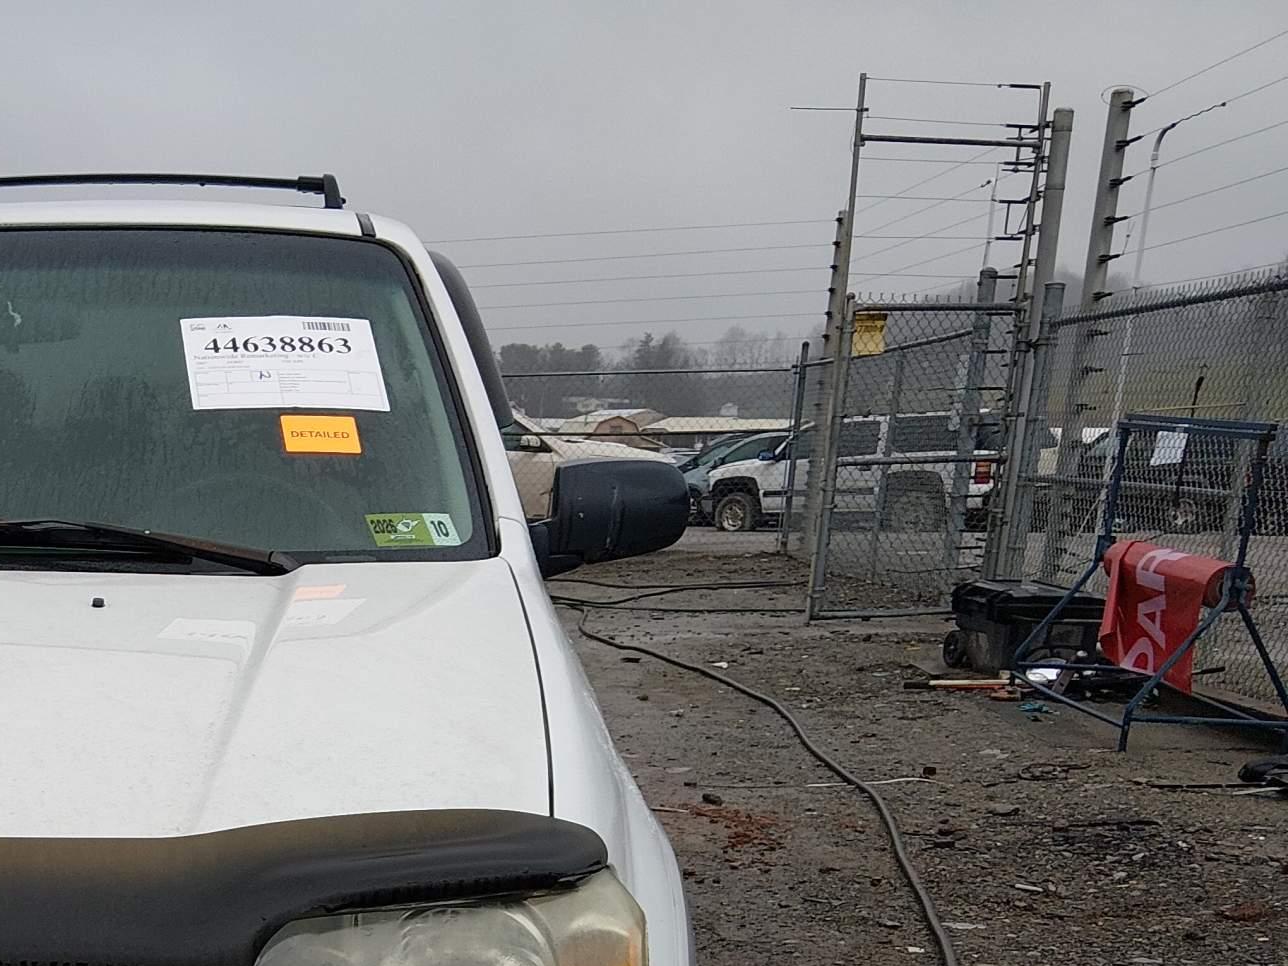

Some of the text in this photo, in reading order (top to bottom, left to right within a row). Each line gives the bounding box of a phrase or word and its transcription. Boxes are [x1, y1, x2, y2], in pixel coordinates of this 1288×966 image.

[204, 336, 352, 354] 44638863
[290, 430, 350, 440] DETAILED
[430, 520, 450, 538] 10
